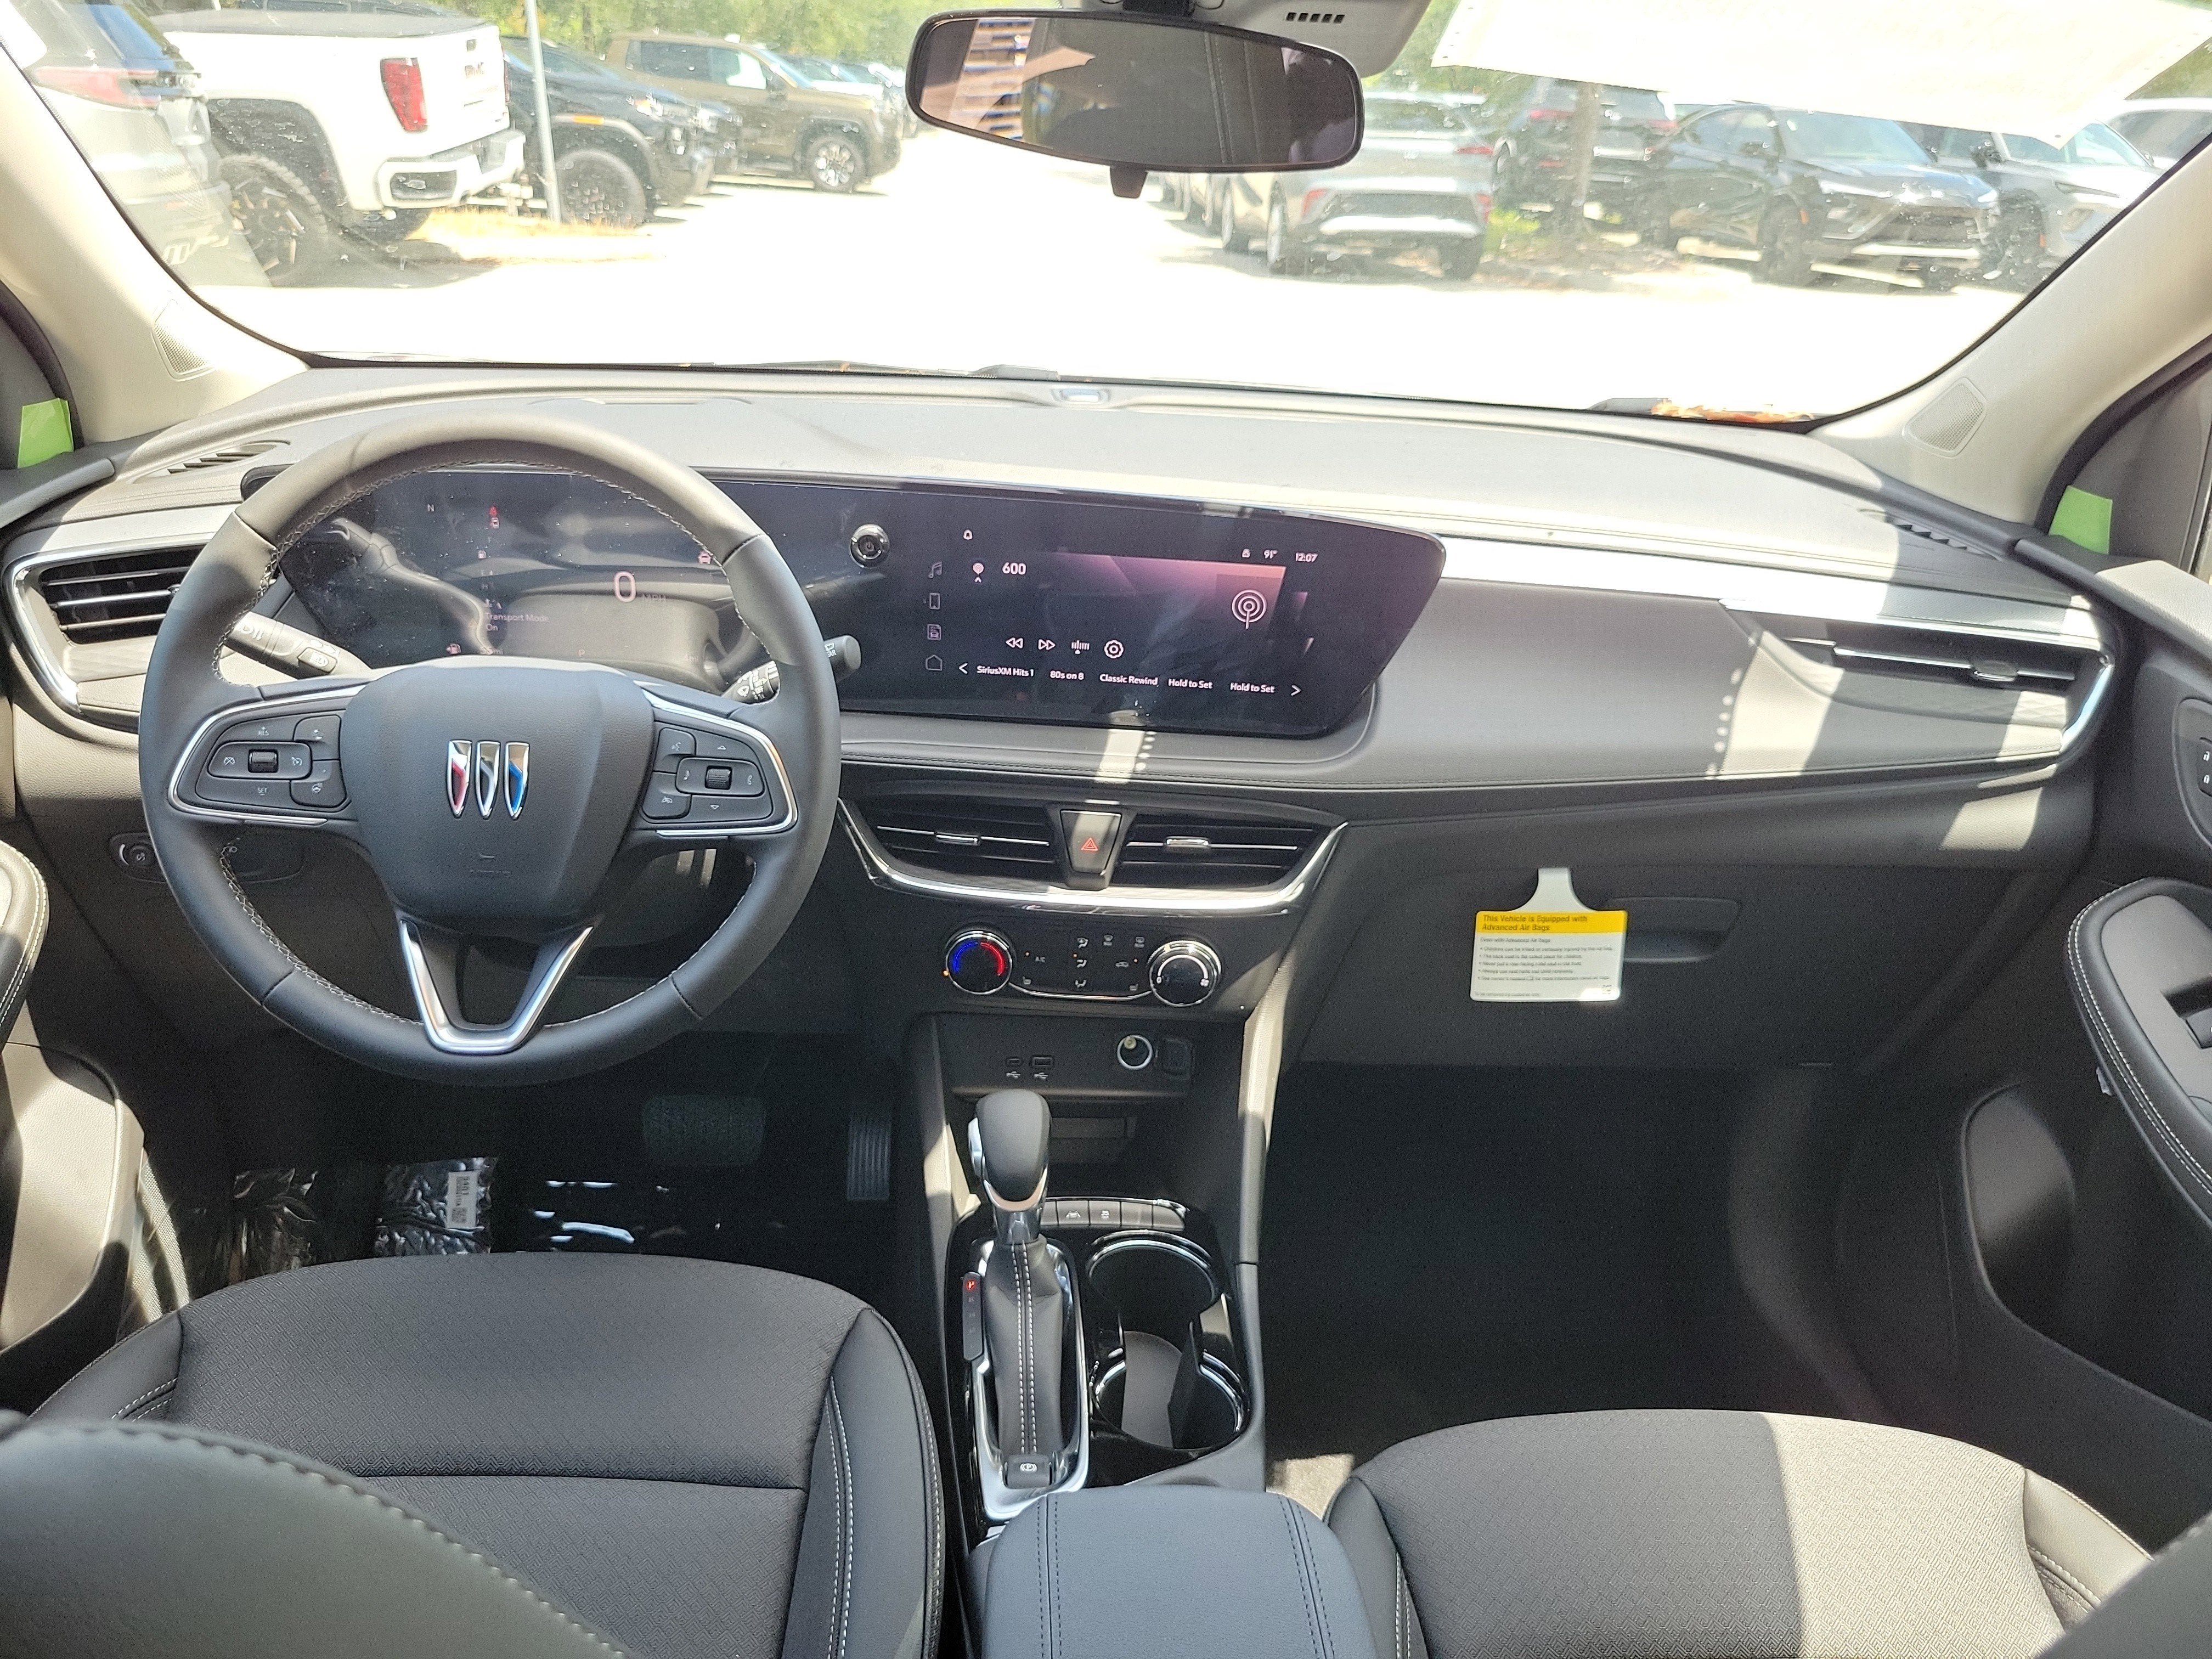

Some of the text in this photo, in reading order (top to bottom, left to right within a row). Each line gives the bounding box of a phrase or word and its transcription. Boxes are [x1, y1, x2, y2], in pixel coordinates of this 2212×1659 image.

[1295, 552, 1318, 562] 12:07
[1002, 562, 1026, 575] 600
[486, 613, 525, 622] Transport
[487, 623, 498, 631] On
[977, 665, 1012, 675] SiriusXM
[1013, 668, 1029, 677] Hits
[1049, 670, 1065, 679] 80s
[1078, 672, 1084, 680] 8
[1099, 674, 1158, 685] Classic Rewind
[1168, 678, 1214, 689] Hold to Set
[1230, 682, 1250, 691] Hold
[1260, 685, 1275, 693] Set
[1532, 924, 1550, 932] Bags
